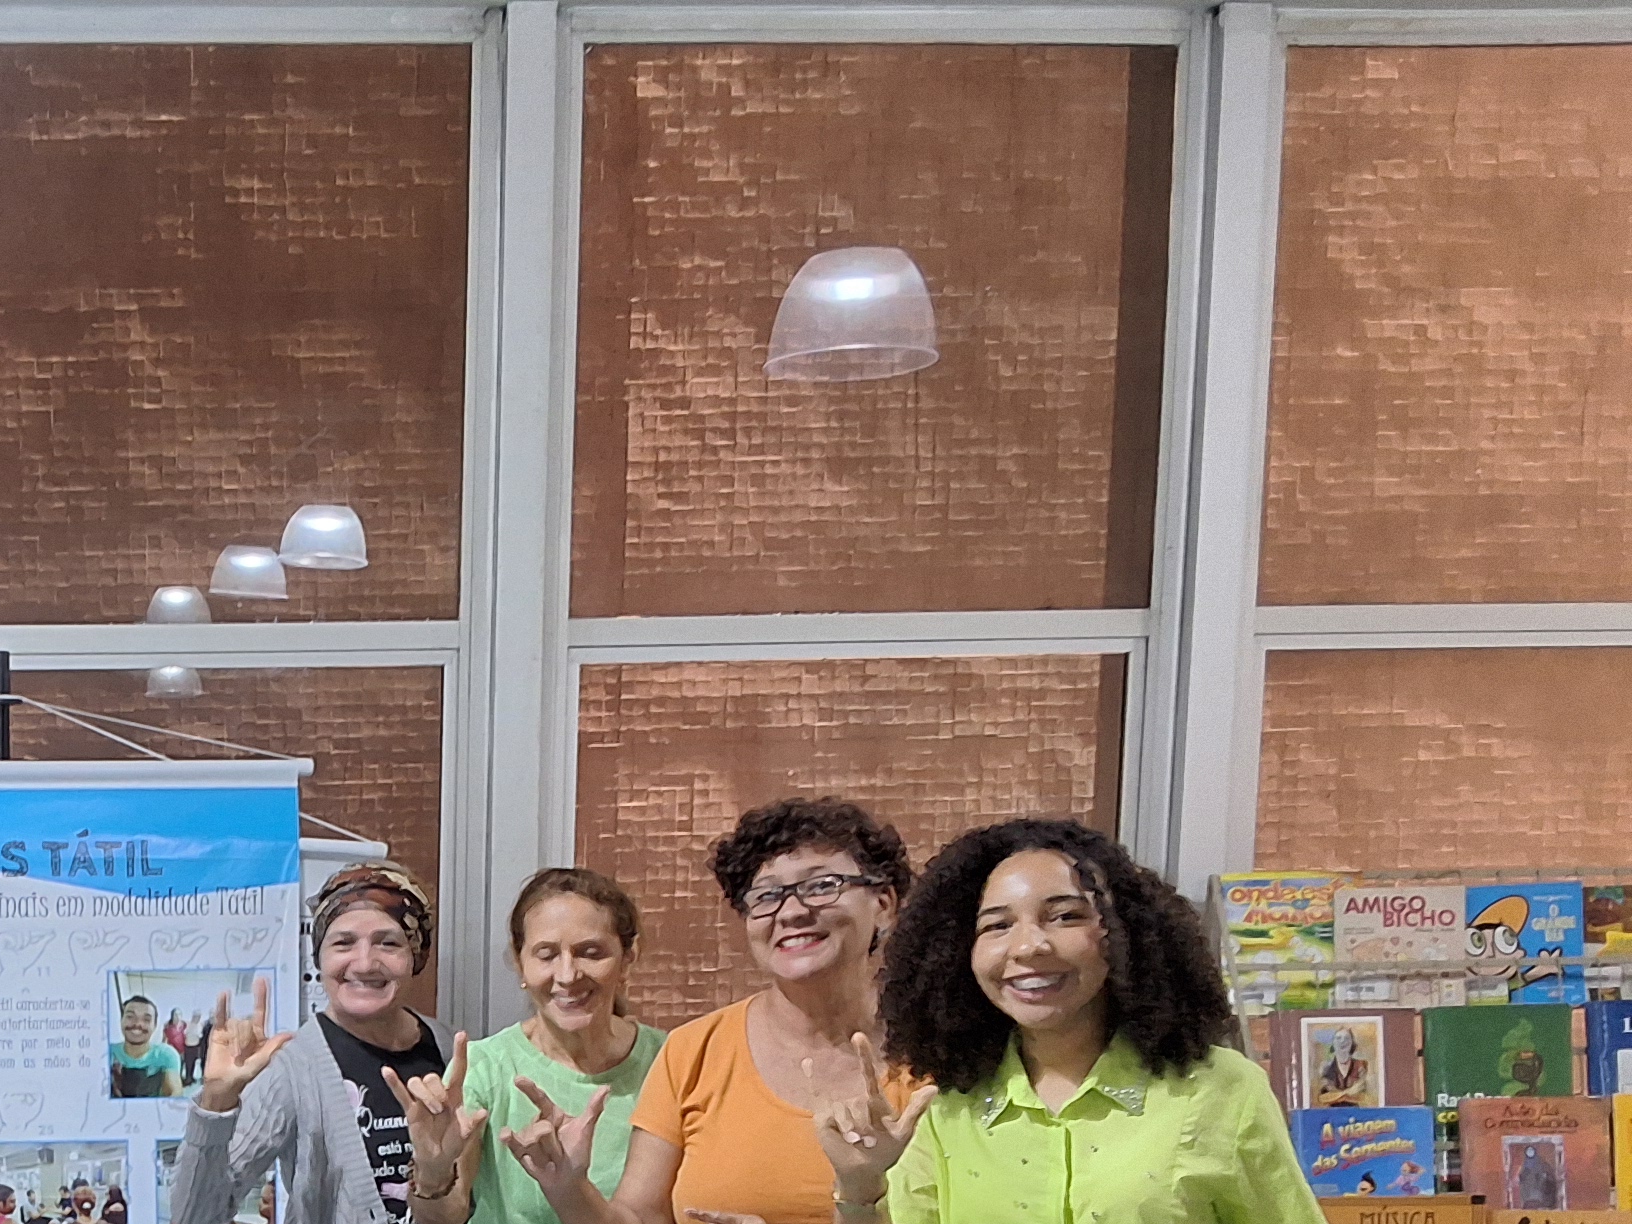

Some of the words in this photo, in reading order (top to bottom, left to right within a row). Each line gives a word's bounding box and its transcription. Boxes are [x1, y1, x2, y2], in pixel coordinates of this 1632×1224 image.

[42, 829, 164, 878] TÁTIL
[57, 898, 84, 919] em
[92, 887, 210, 917] modalidade
[216, 886, 265, 916] Tátil
[1344, 895, 1426, 914] AMIGO
[1383, 908, 1455, 927] BICHO
